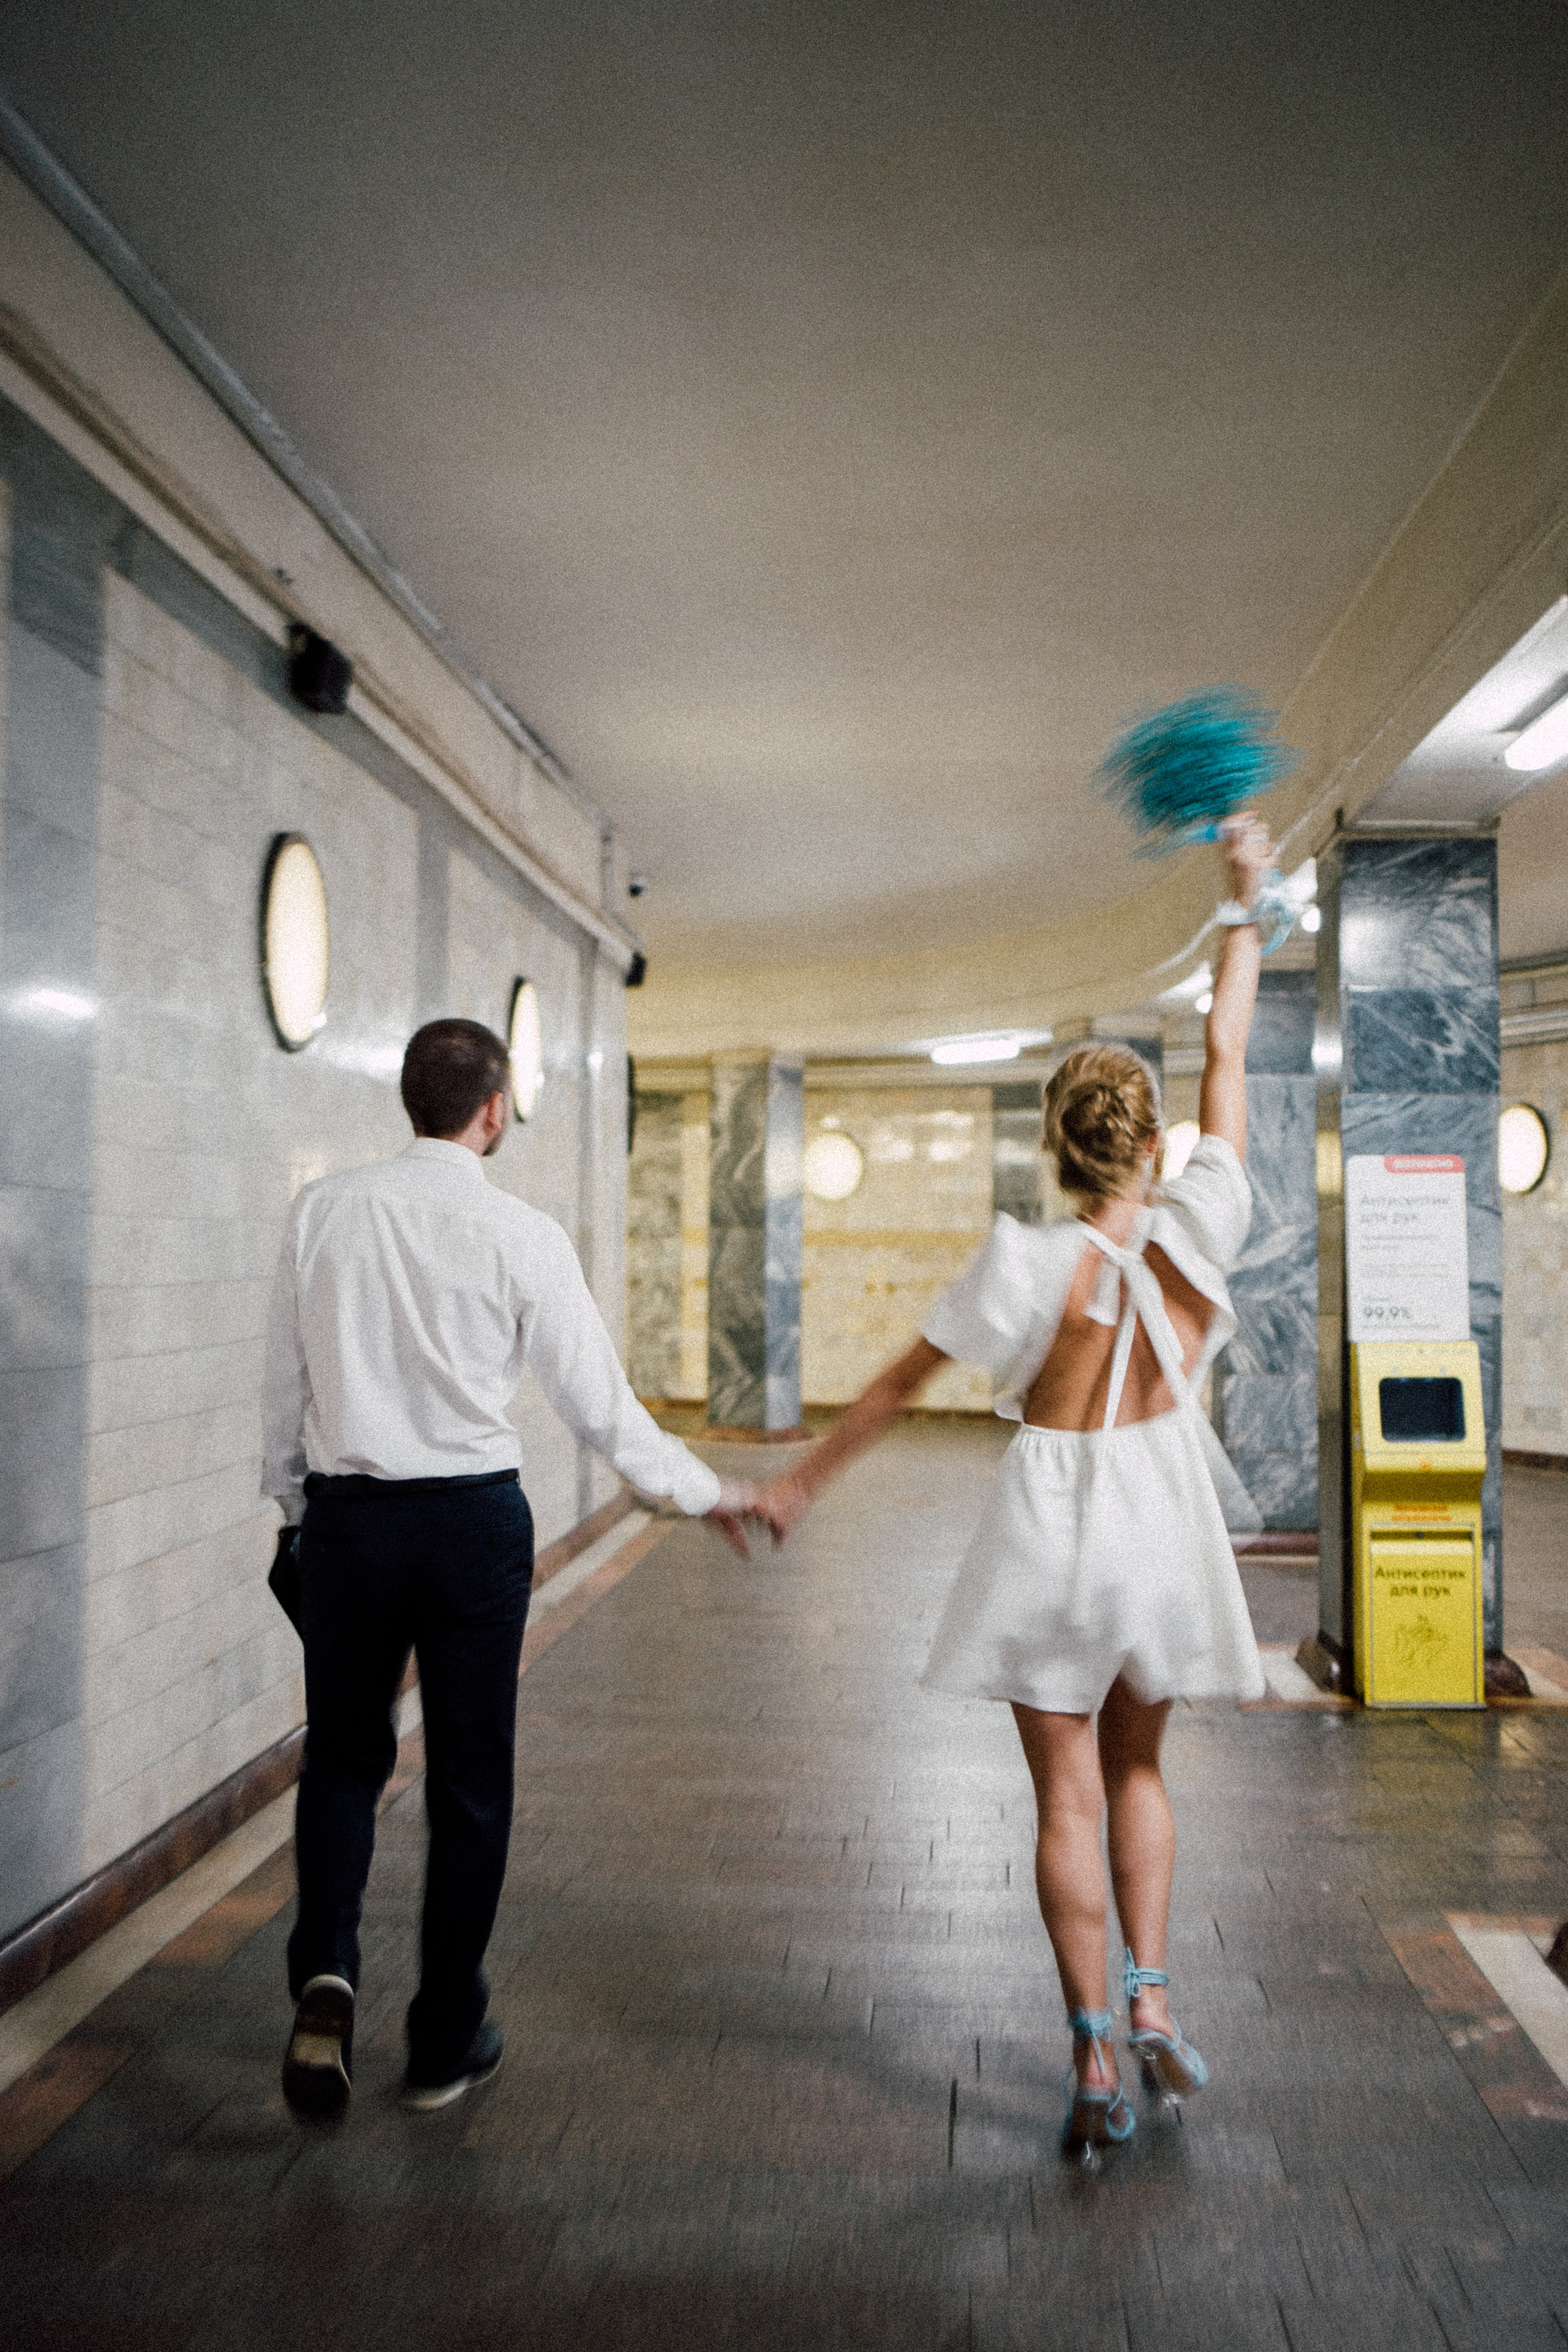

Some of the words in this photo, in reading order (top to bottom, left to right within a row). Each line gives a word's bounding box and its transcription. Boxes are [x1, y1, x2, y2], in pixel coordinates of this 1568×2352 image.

[1375, 1566, 1465, 1579] Антисептик
[1390, 1586, 1417, 1597] для
[1423, 1586, 1450, 1599] рук
